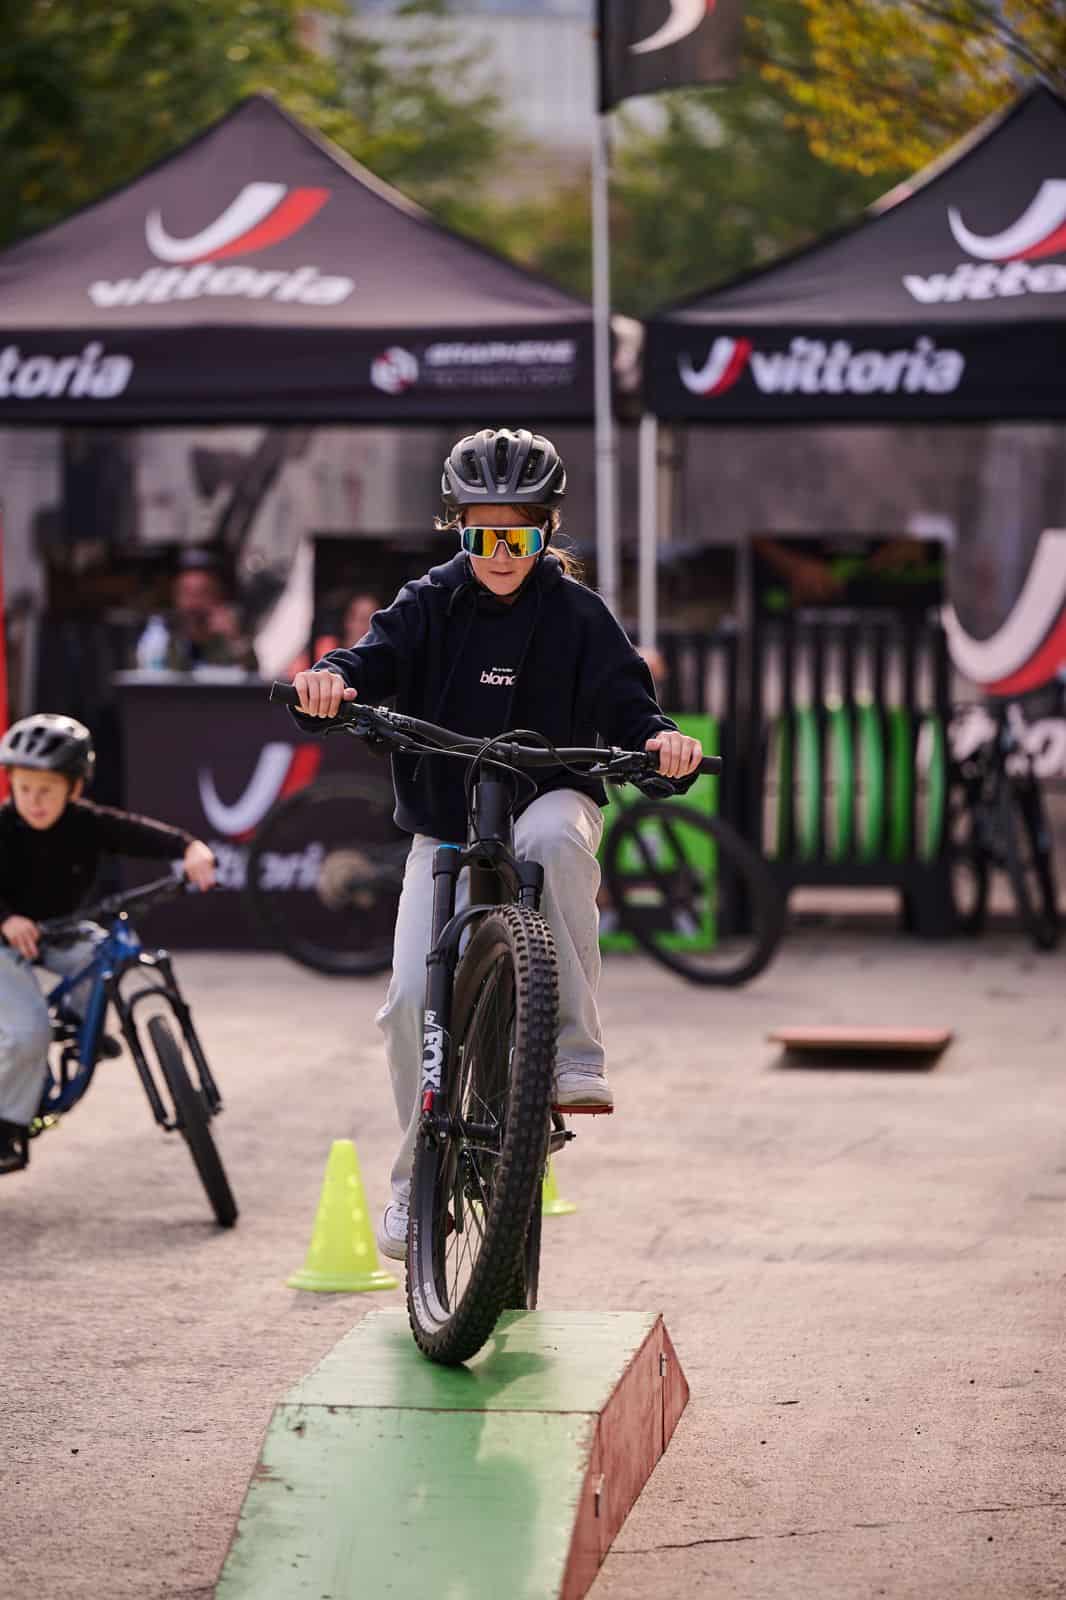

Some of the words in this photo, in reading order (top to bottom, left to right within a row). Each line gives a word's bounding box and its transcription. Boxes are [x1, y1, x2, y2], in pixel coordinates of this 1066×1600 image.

[89, 264, 355, 306] vittoria
[750, 336, 965, 395] vittoria
[421, 1029, 444, 1090] FOX
